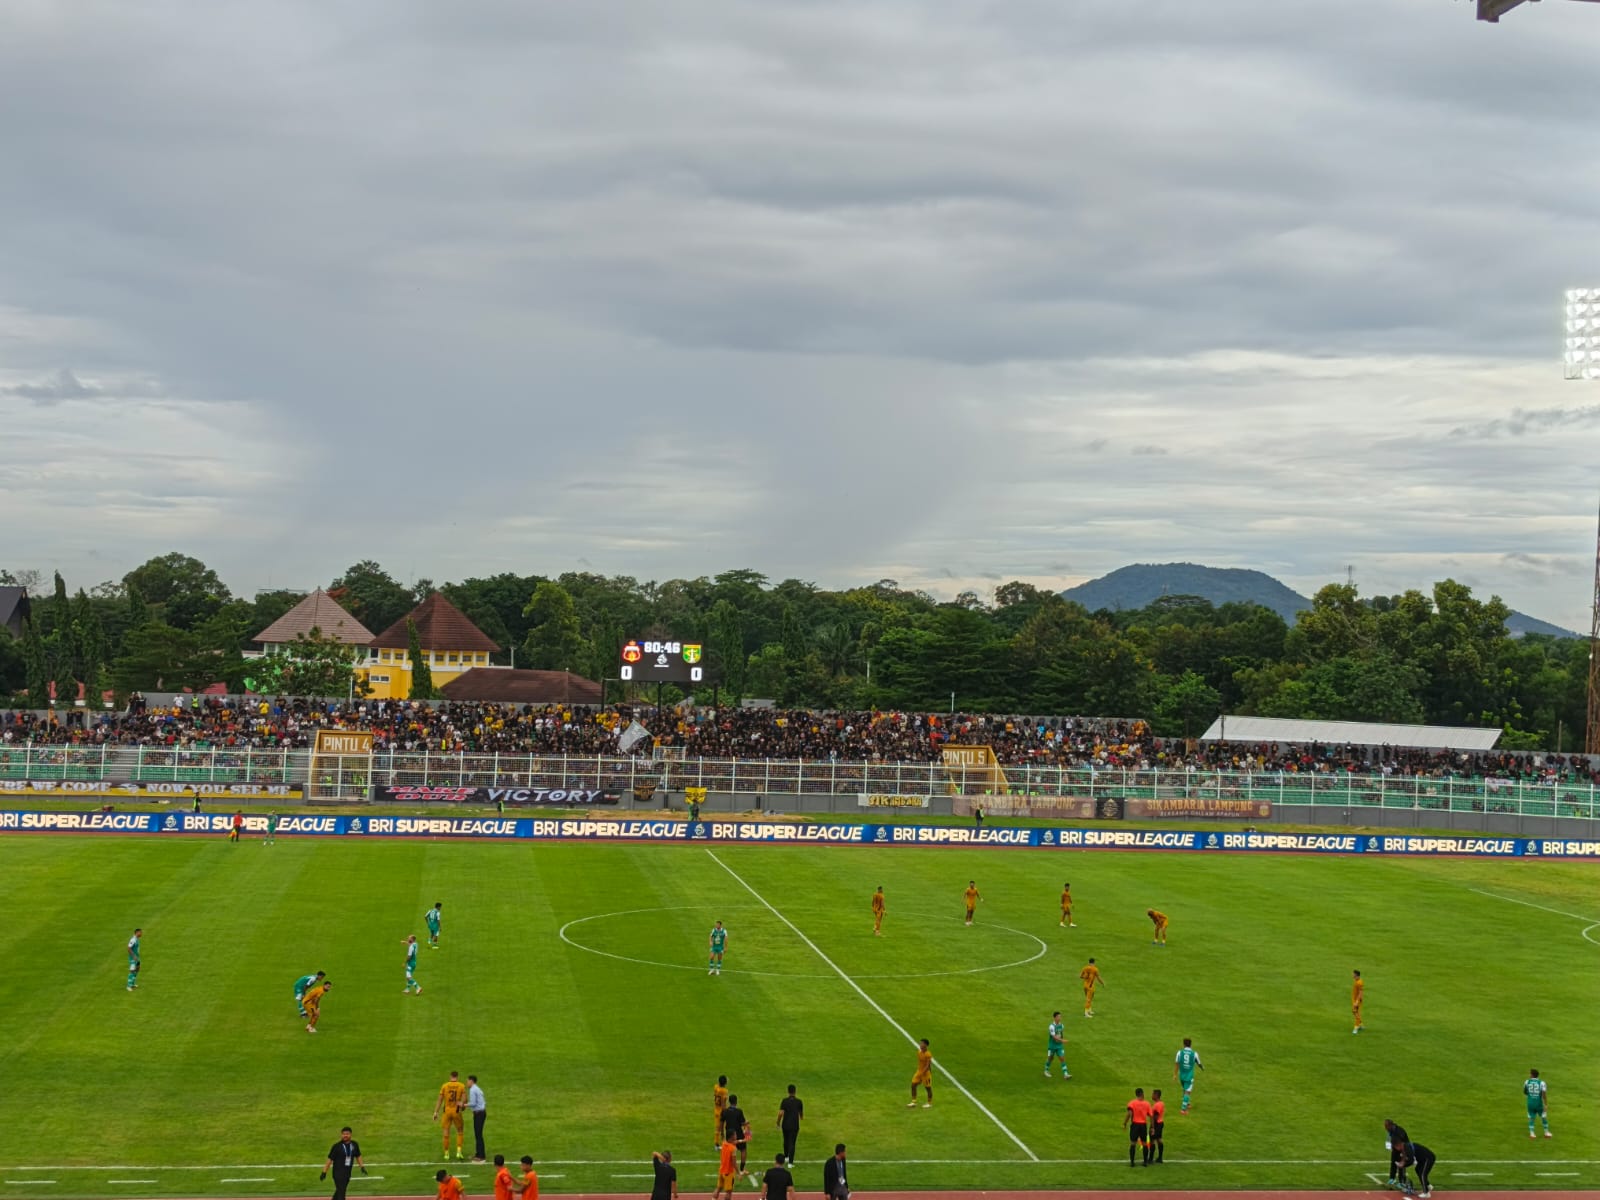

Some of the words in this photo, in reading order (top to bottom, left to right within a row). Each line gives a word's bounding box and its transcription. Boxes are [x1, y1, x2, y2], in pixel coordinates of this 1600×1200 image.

[621, 665, 632, 680] 0
[691, 667, 702, 681] 0
[323, 736, 358, 751] PINTU
[362, 738, 369, 751] 4
[943, 751, 974, 765] PINTU
[31, 781, 57, 792] WE
[61, 782, 112, 793] COME
[146, 783, 188, 794] NOW
[191, 784, 226, 794] YOU
[230, 785, 263, 795] SEE
[267, 785, 291, 796] ME
[487, 787, 601, 802] VICTORY
[1208, 800, 1253, 811] LAMPUNG
[184, 816, 209, 830] BRI
[368, 818, 393, 833] BRI
[533, 821, 559, 836] BRI
[712, 823, 737, 838] BRI
[893, 826, 915, 841] BRI
[1060, 831, 1082, 845] BRI
[1223, 834, 1246, 848] BRI
[1384, 837, 1405, 851] BRI
[1542, 841, 1564, 854] BRI
[1183, 1053, 1190, 1064] 9
[1528, 1083, 1540, 1093] 22
